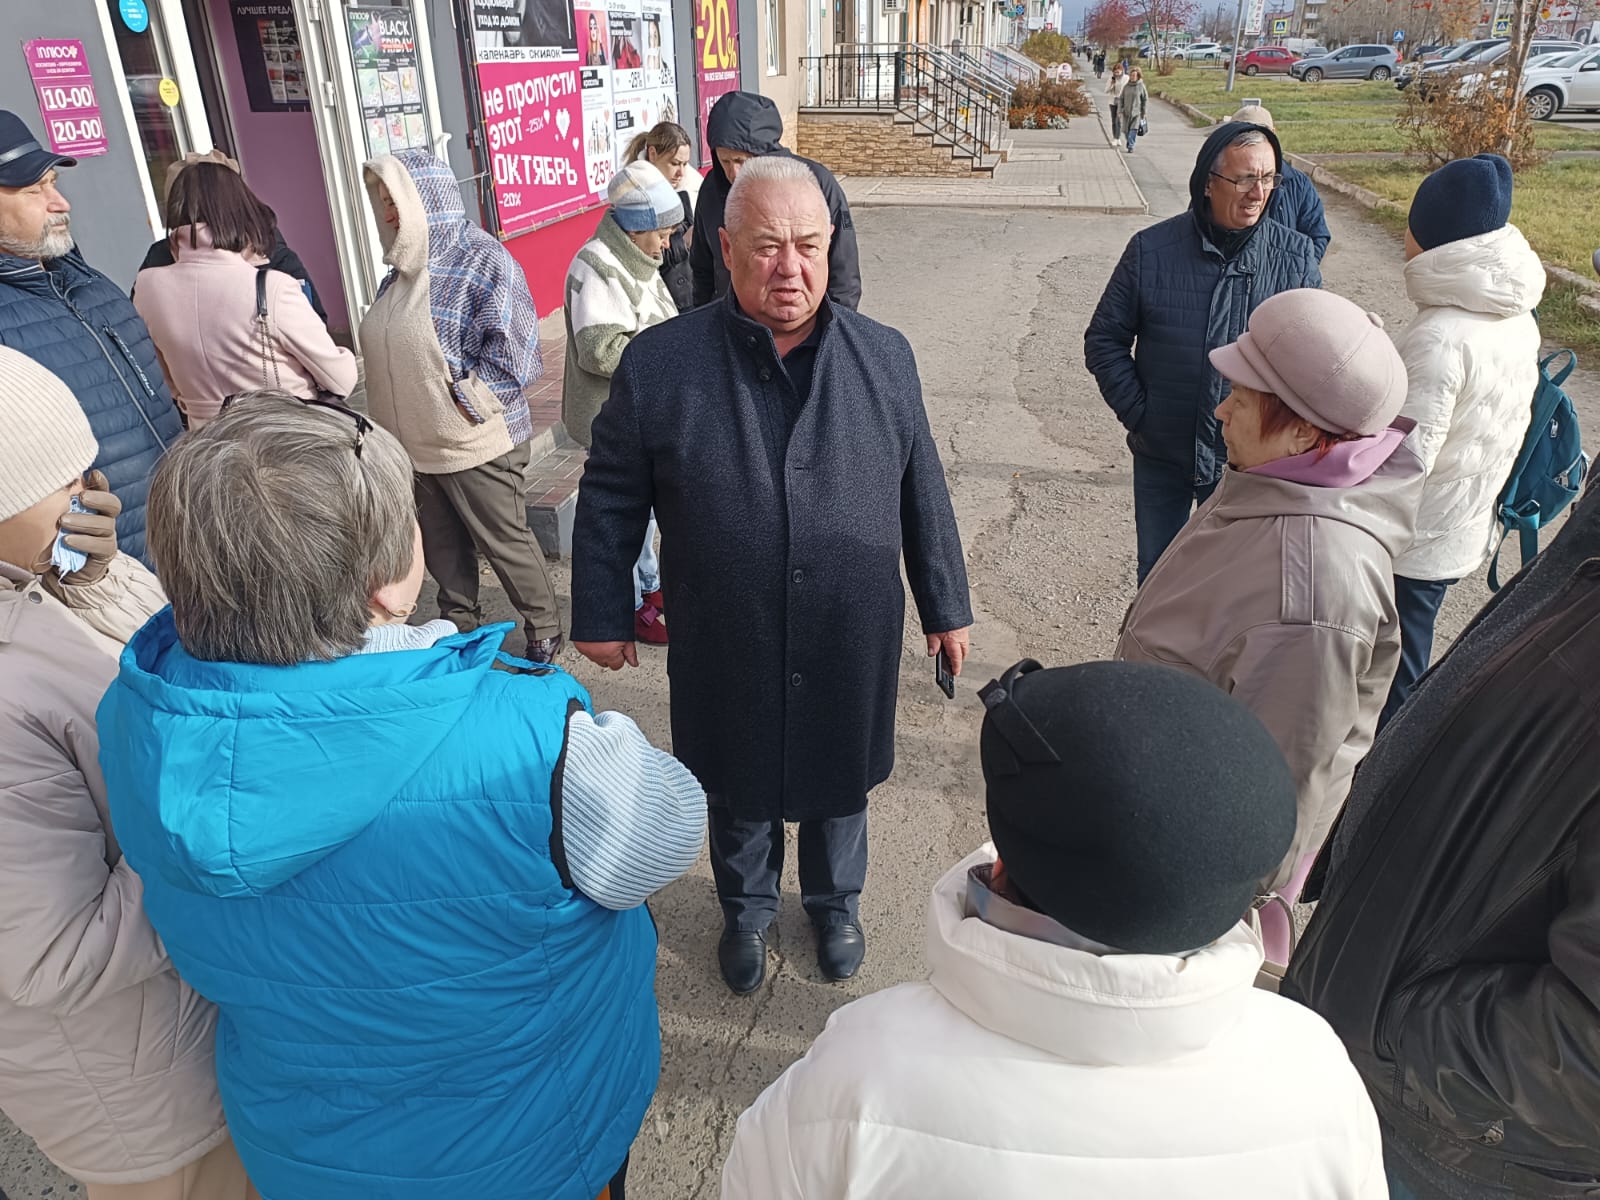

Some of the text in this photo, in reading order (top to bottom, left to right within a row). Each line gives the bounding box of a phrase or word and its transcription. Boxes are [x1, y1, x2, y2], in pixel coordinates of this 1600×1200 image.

[237, 6, 267, 15] ЛУЧШЕЕ
[379, 20, 409, 36] BLACK
[697, 0, 737, 69] -20%
[45, 86, 92, 109] 10-00
[483, 87, 504, 117] не
[505, 70, 577, 115] пропусти
[54, 119, 101, 142] 20-00
[525, 116, 544, 133] -25%
[494, 153, 578, 186] ОКТЯБРЬ
[588, 159, 615, 186] -25%
[499, 191, 522, 207] -20%
